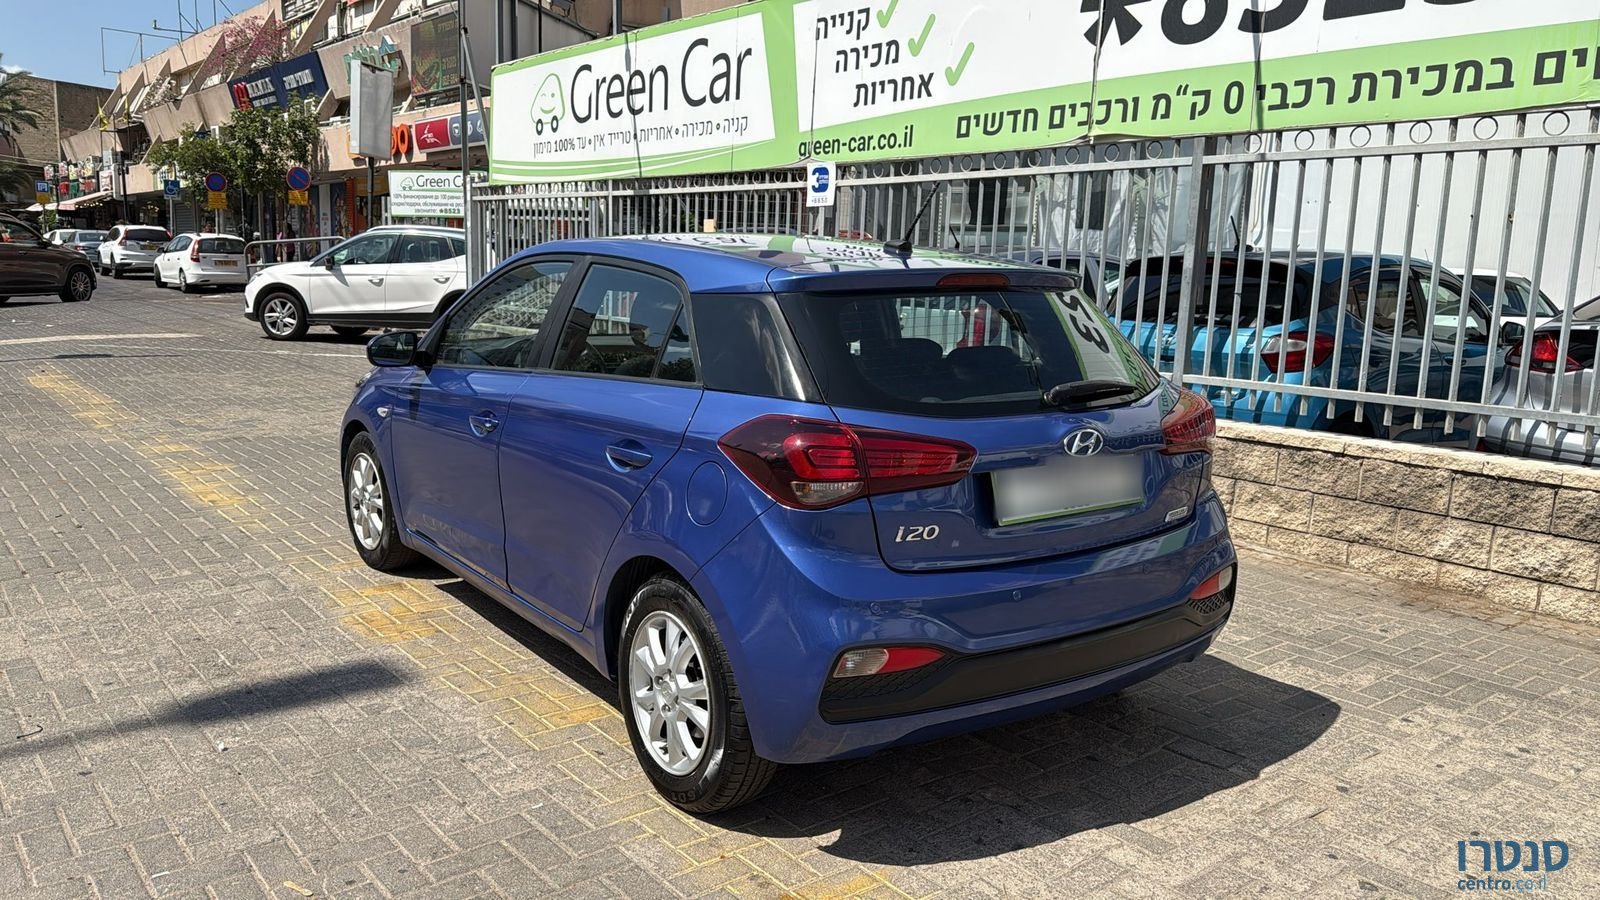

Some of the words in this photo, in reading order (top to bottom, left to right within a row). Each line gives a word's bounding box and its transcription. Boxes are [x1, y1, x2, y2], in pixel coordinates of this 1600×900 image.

[816, 7, 870, 40] קנייה
[835, 39, 899, 73] מכירה
[1533, 47, 1600, 86] ים
[570, 64, 668, 123] Green
[681, 38, 752, 107] Car
[853, 72, 934, 108] אחריות
[1256, 76, 1336, 111] רכבי
[1347, 57, 1515, 103] במכירת
[1048, 97, 1140, 129] ורכבים
[1223, 81, 1245, 114] 0
[639, 125, 673, 143] אחריות
[682, 120, 713, 137] מכירה
[723, 116, 748, 136] קניה
[956, 108, 1038, 139] חדשים
[533, 141, 552, 158] מימון
[554, 139, 575, 152] 100%
[577, 136, 586, 149] עד
[593, 134, 605, 151] אין
[798, 125, 914, 157] green-car.co.il
[416, 175, 451, 188] Green
